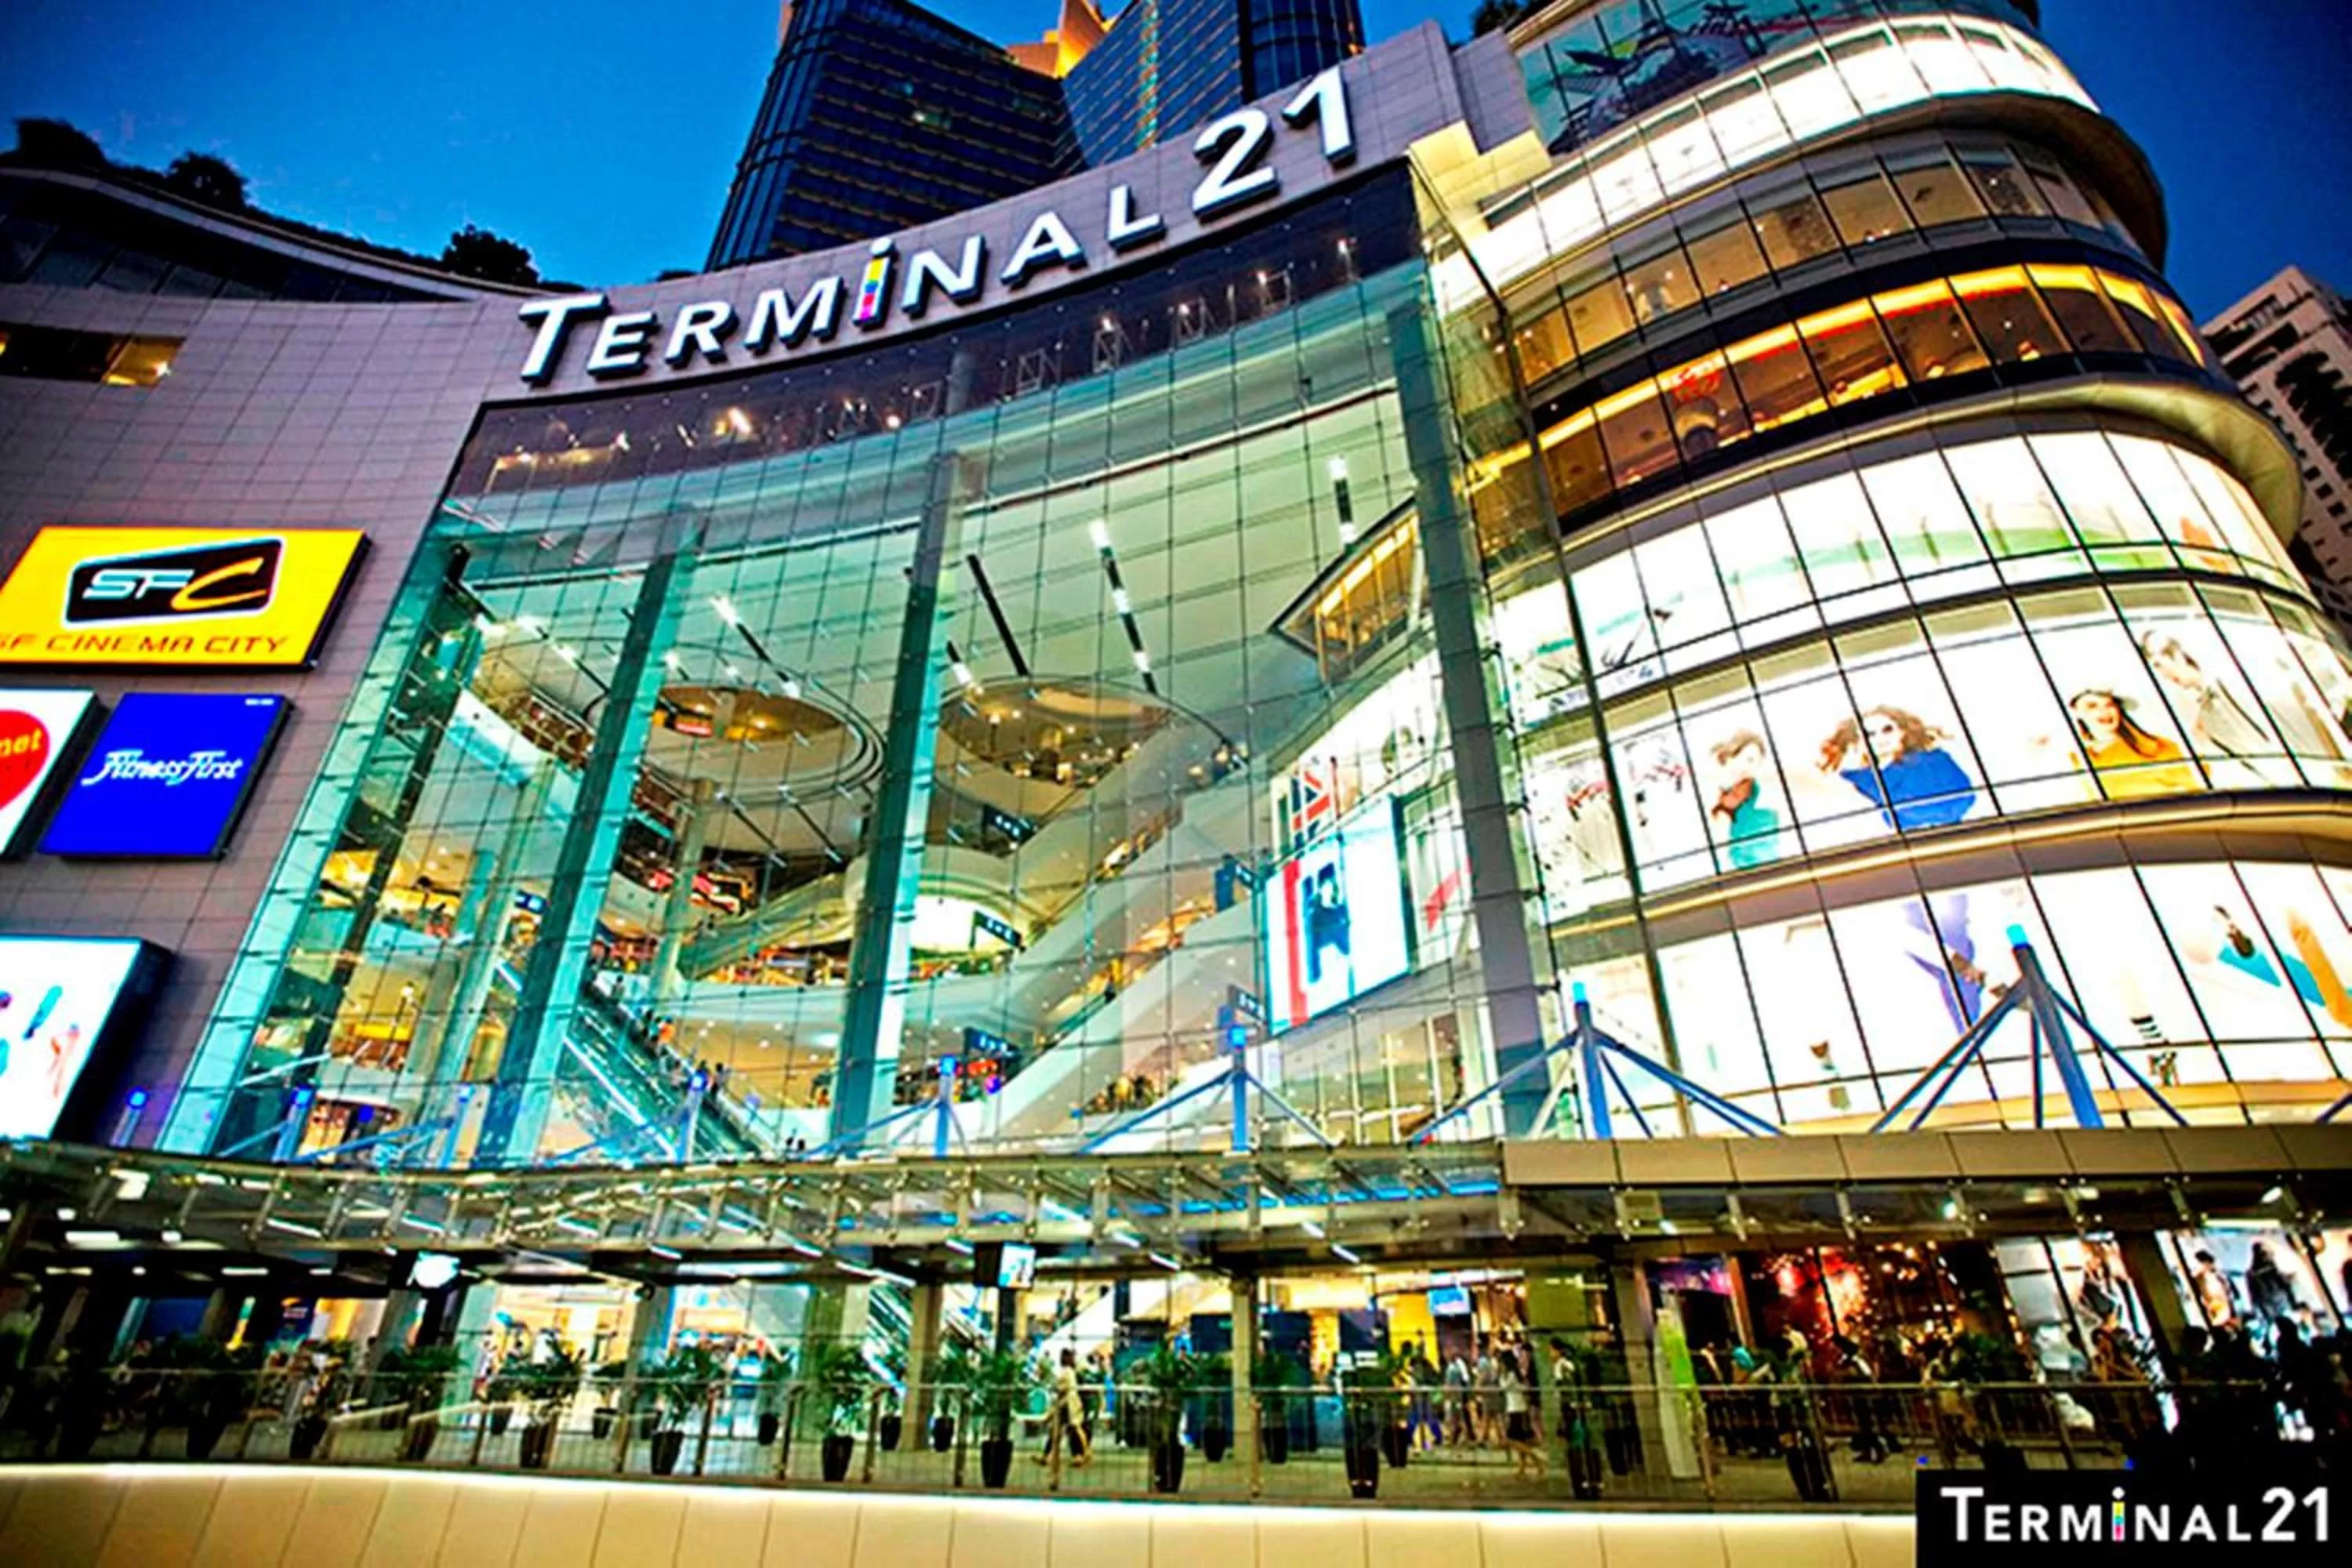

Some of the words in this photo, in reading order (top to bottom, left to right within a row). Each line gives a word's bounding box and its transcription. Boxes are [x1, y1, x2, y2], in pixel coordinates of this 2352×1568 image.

[1192, 64, 1357, 223] 21
[82, 557, 267, 612] SFC
[0, 634, 38, 651] F
[45, 633, 194, 654] CINEMA
[204, 635, 287, 654] CITY
